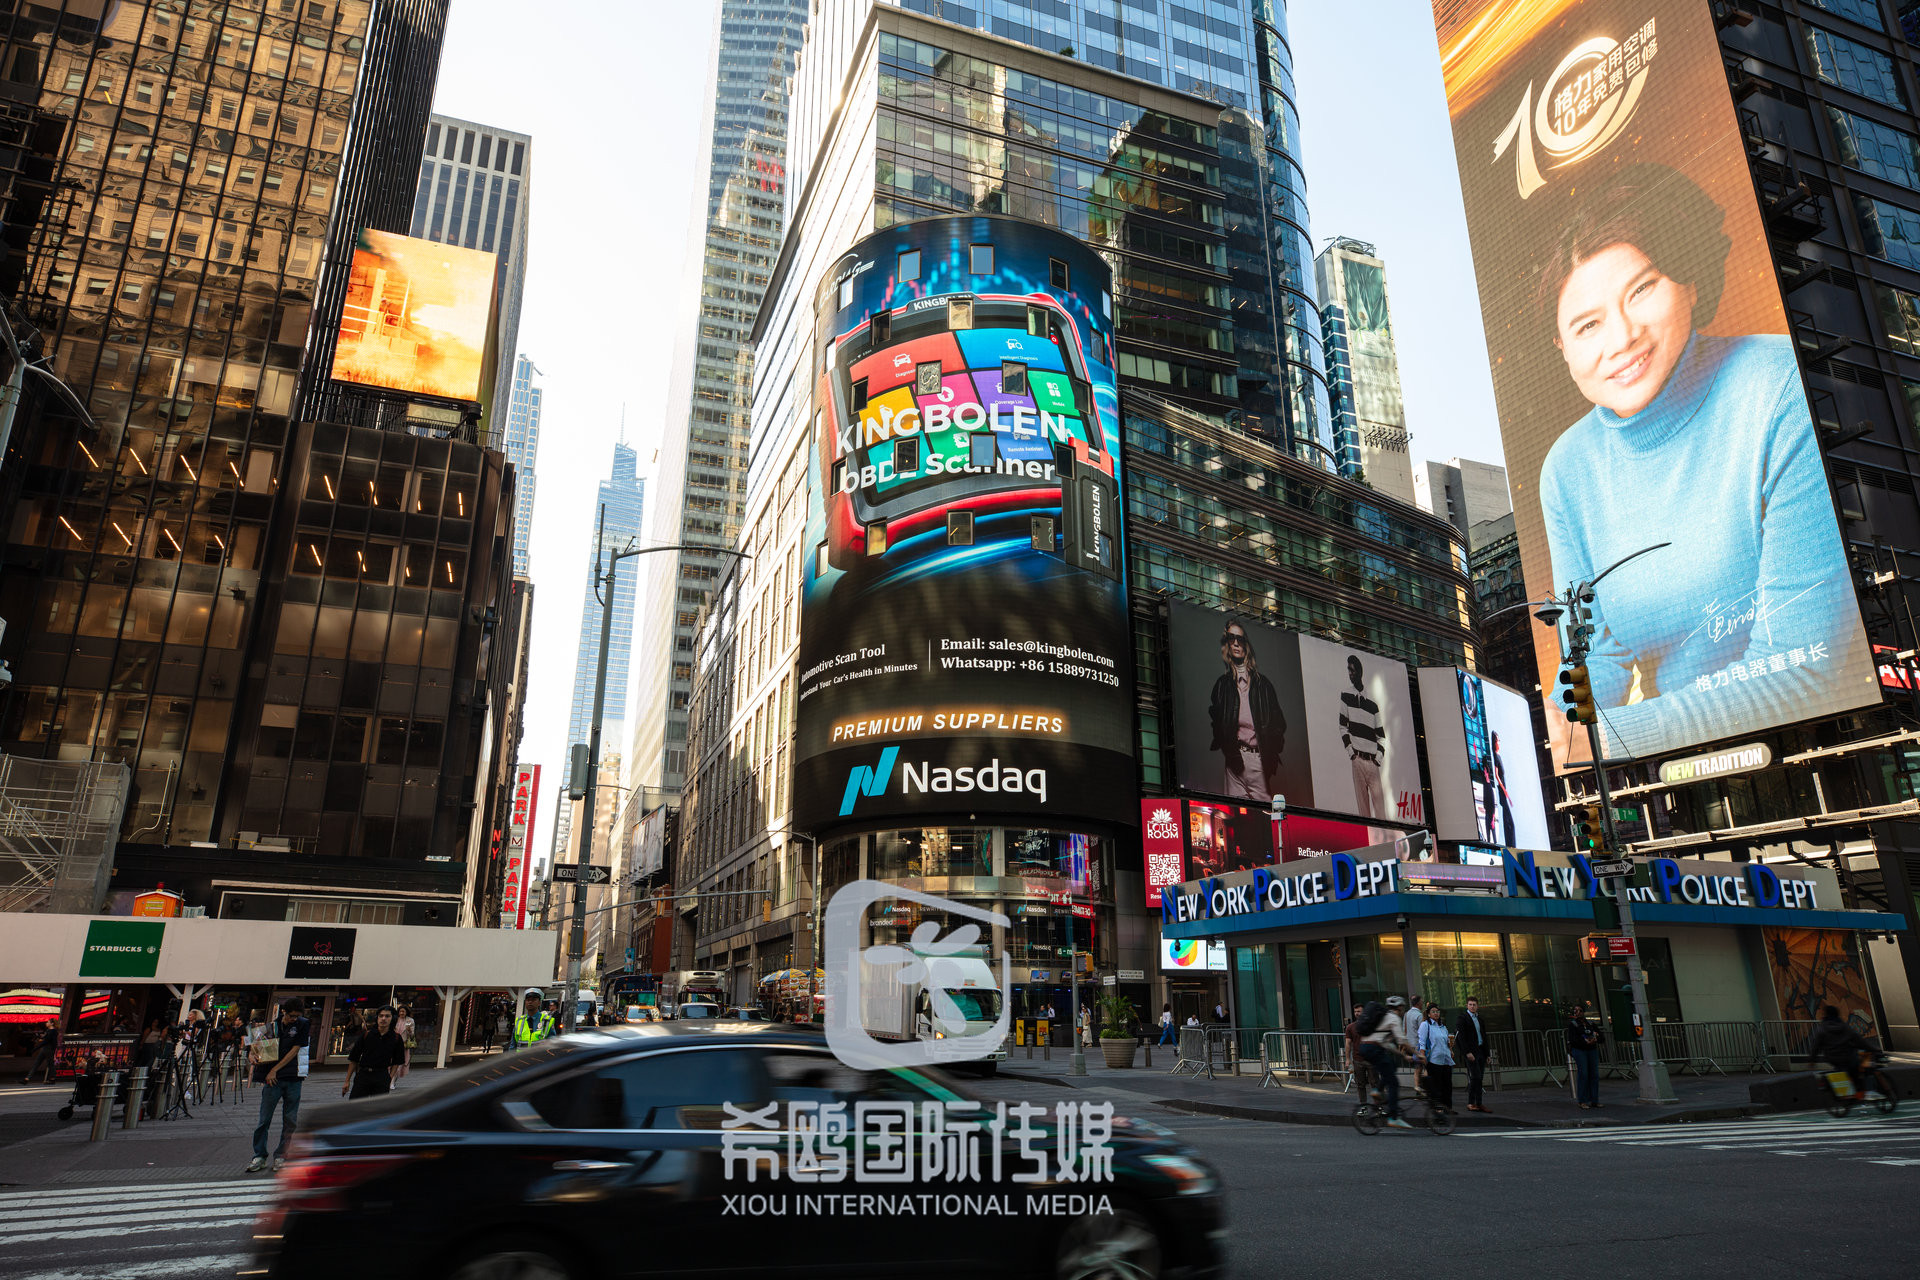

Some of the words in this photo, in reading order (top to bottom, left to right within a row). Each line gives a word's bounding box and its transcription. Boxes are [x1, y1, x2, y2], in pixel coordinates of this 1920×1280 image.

[1554, 16, 1656, 118] 格力家用空调
[1554, 37, 1659, 136] 10年免费包修
[913, 294, 972, 311] KINGB
[836, 403, 1067, 458] KINGBOLEN
[835, 652, 857, 666] Scan
[860, 643, 886, 659] Tool
[940, 638, 985, 650] Email:
[988, 638, 1115, 668] sales@kingbolen.com
[1695, 641, 1829, 693] 格力电器董事长
[819, 679, 832, 689] Your
[833, 674, 848, 684] Car's
[849, 669, 873, 680] Health
[874, 667, 882, 675] in
[884, 663, 918, 674] Minutes
[940, 656, 1016, 672] Whatsapp:
[1019, 659, 1045, 672] +86
[1048, 661, 1120, 687] 15889731250
[833, 715, 923, 742] PREMIUM
[933, 713, 1063, 733] SUPPLIERS
[902, 758, 1047, 803] Nasdaq
[513, 772, 531, 825] PARK
[1396, 790, 1422, 822] H&M
[1147, 823, 1178, 832] LOTUS
[1147, 831, 1179, 839] ROOM
[1297, 846, 1324, 857] Refined
[1501, 848, 1576, 899] NEW
[1654, 858, 1750, 907] POLICE
[1748, 864, 1817, 909] DEPT
[1595, 864, 1609, 874] ONE
[1614, 862, 1629, 872] WAY
[503, 857, 521, 912] PARK
[1161, 885, 1200, 924] NEW
[1199, 877, 1252, 919] YORK
[1253, 868, 1326, 912] POLICE
[1331, 852, 1399, 900] DEPT
[1026, 906, 1047, 914] Nasdaq
[89, 945, 142, 953] STARBUCKS
